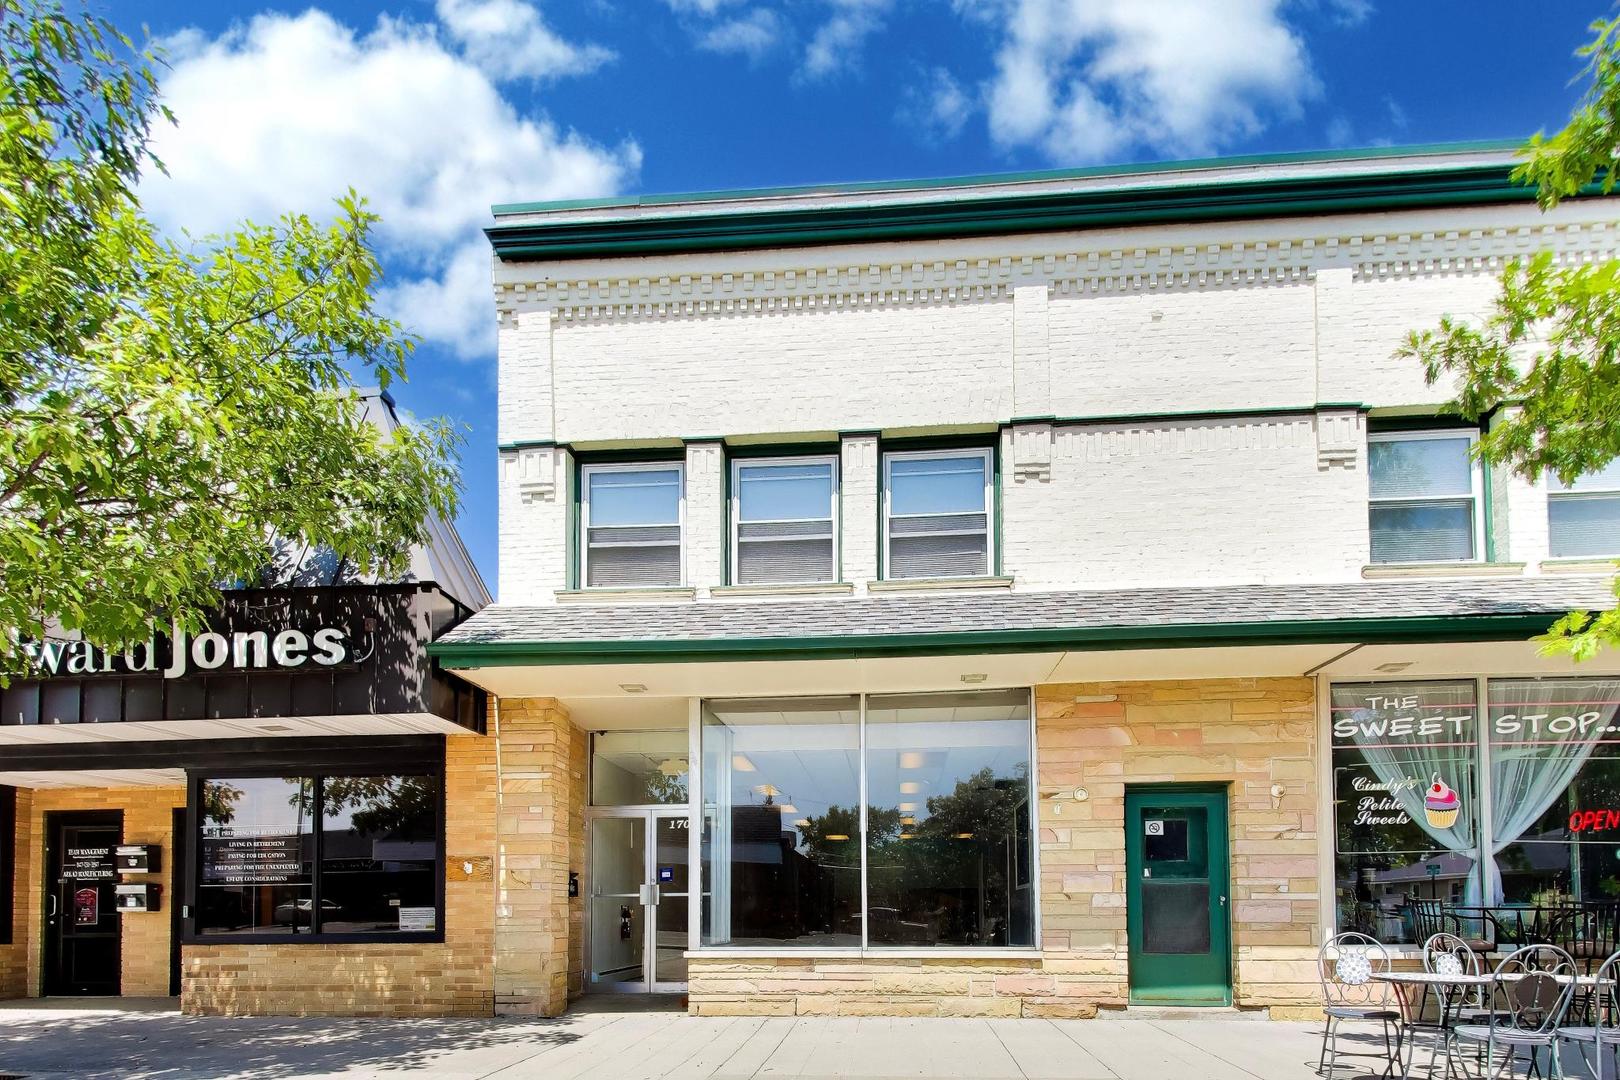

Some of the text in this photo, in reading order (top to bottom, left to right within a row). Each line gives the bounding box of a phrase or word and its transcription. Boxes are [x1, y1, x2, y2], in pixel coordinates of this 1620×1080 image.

[6, 612, 347, 680] ward Jones
[1365, 695, 1419, 710] THE
[1333, 714, 1473, 738] SWEET
[1351, 776, 1416, 796] Cindy's
[1353, 810, 1413, 826] Sweets
[1568, 809, 1620, 834] OPEN
